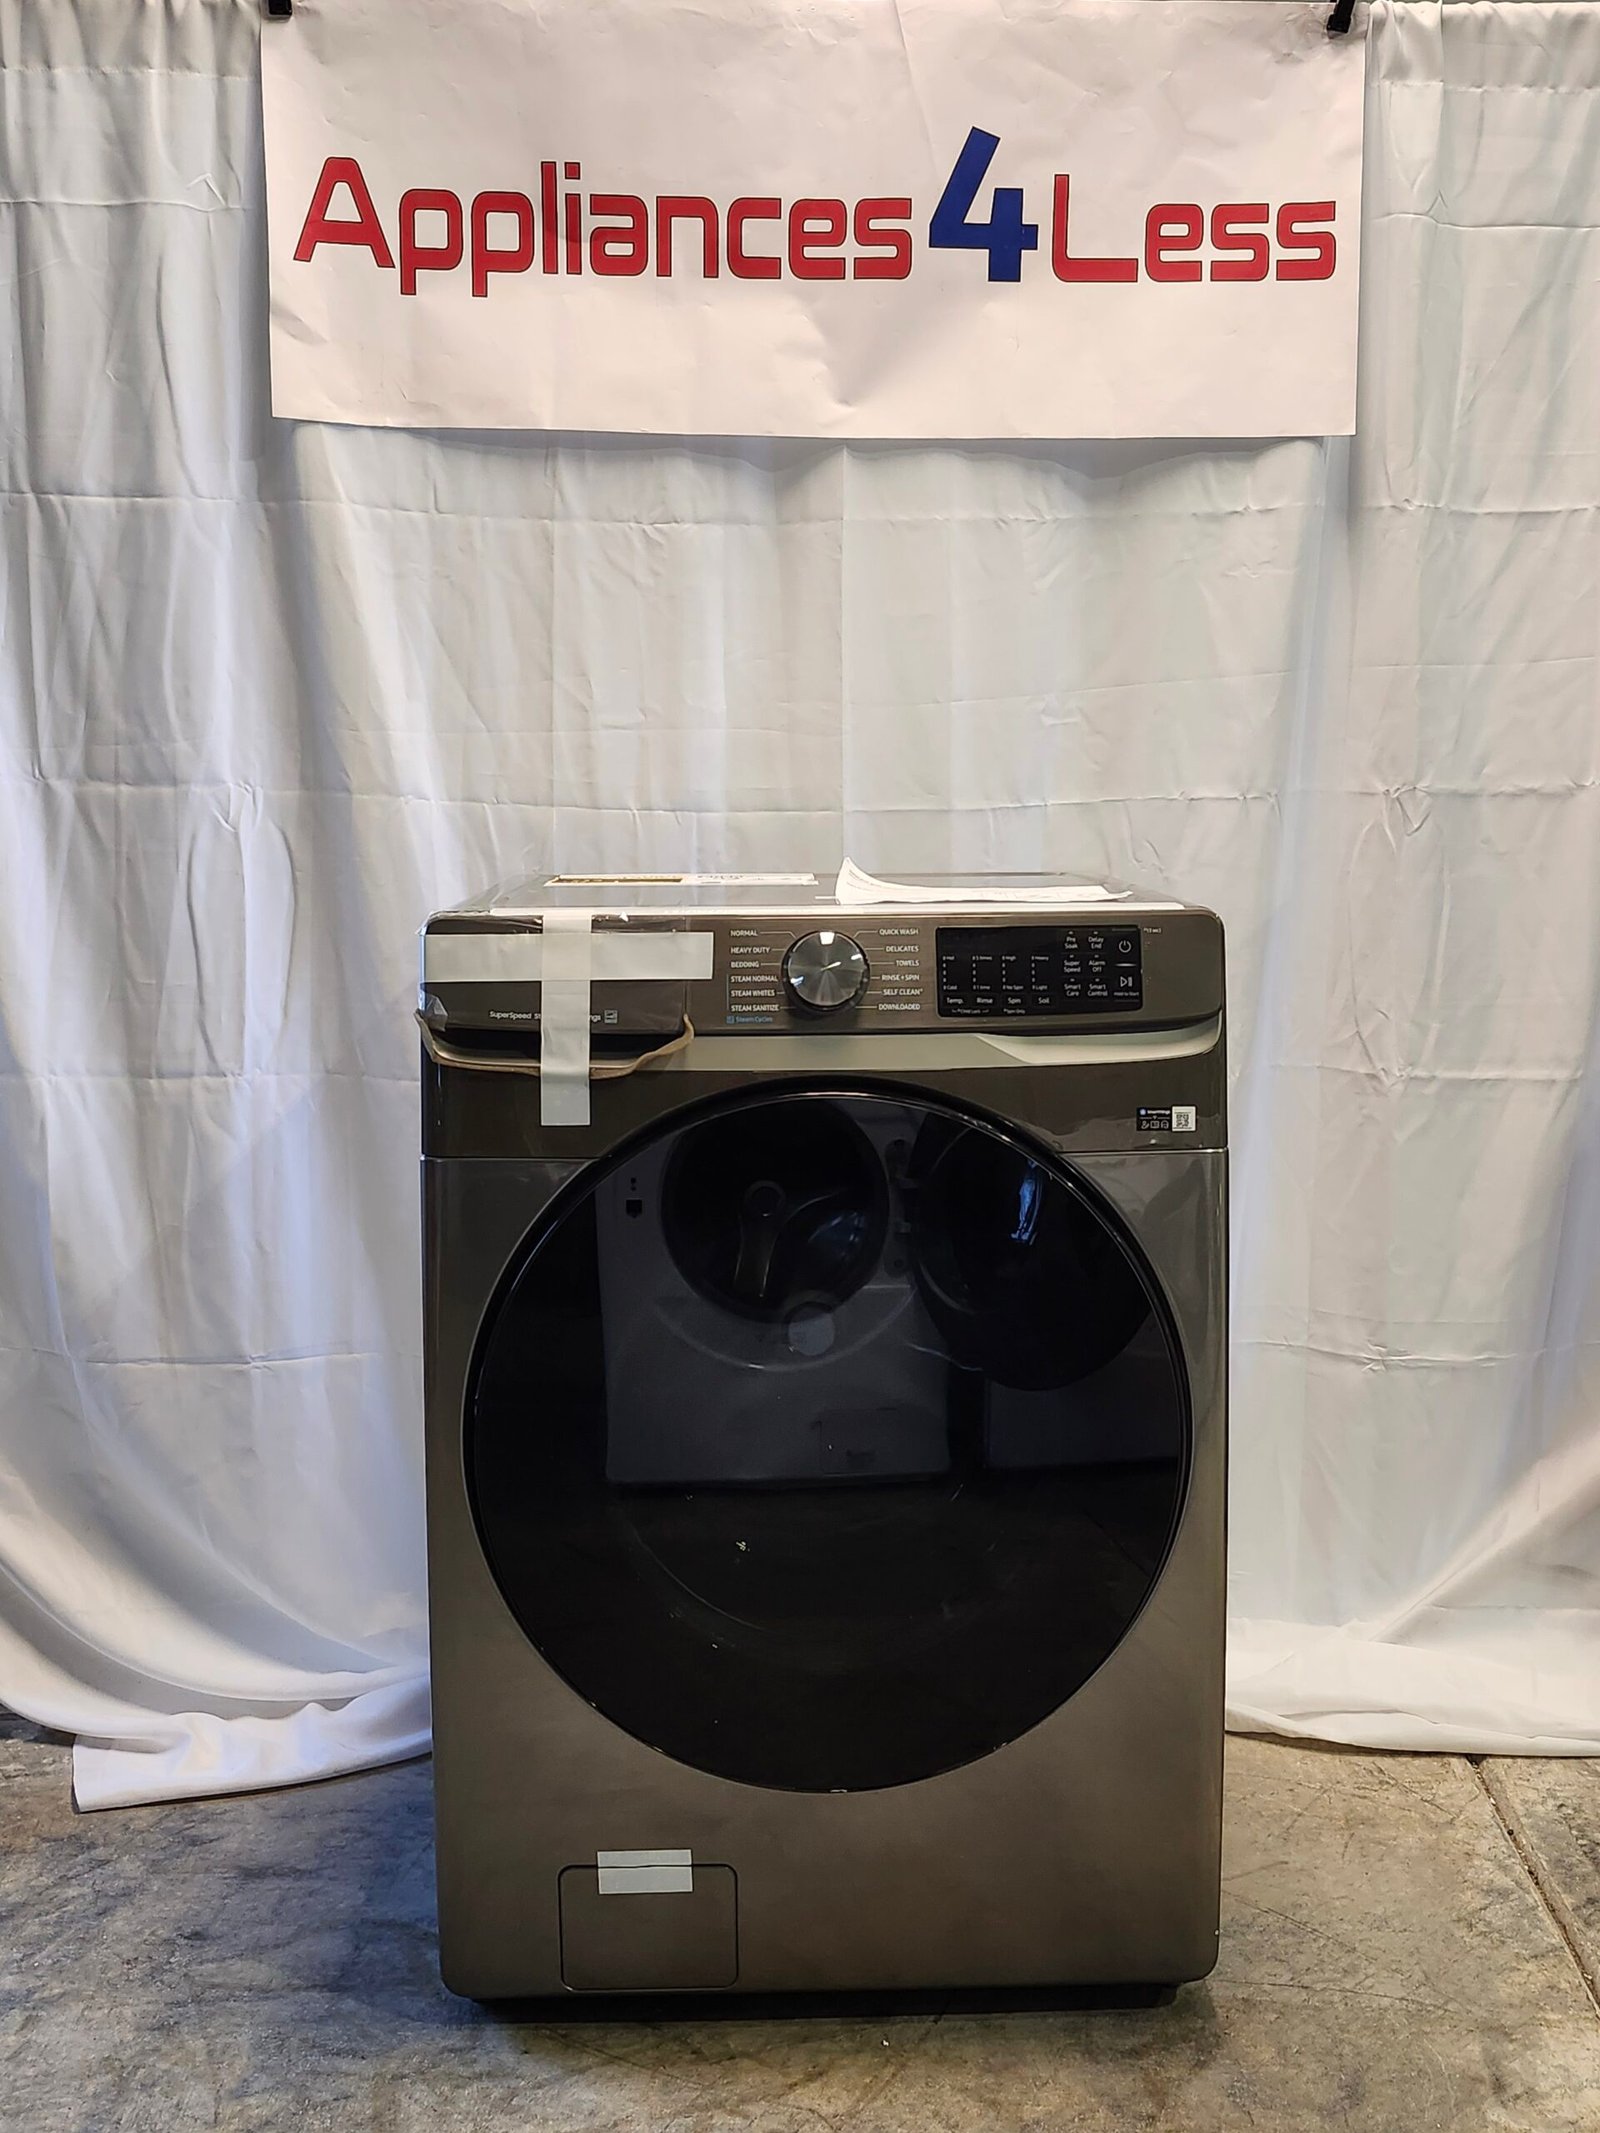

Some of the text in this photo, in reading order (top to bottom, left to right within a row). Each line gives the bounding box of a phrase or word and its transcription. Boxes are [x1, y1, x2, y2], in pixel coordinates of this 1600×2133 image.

[730, 929, 758, 937] NORMAL
[879, 928, 899, 936] QUICK
[730, 961, 760, 969] BEDDING
[731, 975, 751, 983] STEAM
[883, 988, 898, 996] SELF
[731, 1004, 780, 1012] STEAM SANITIZE
[878, 1003, 921, 1011] DOWNLOADED
[489, 1010, 532, 1020] SuperSpeed
